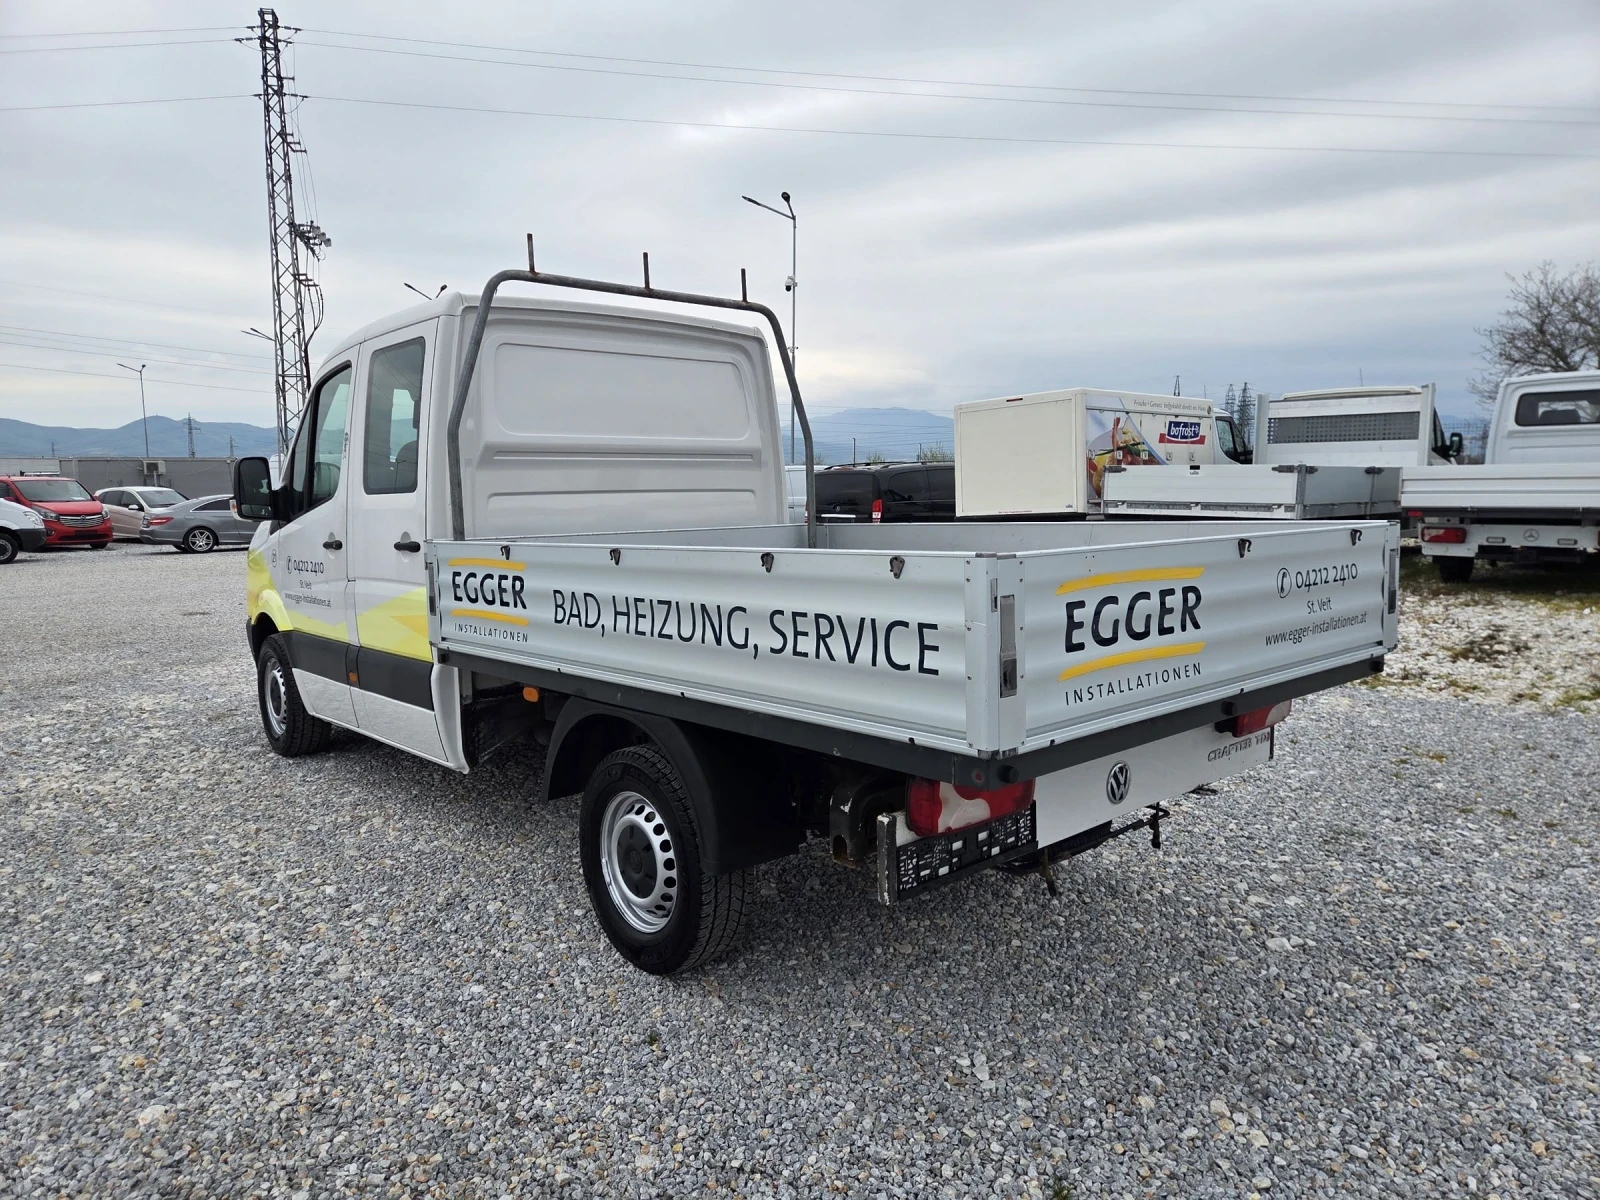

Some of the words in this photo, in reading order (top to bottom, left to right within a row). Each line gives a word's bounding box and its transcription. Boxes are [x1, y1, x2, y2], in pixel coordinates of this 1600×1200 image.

[293, 559, 309, 575] 04212
[310, 561, 325, 577] 2410
[1295, 567, 1330, 593] 04212
[1332, 563, 1358, 587] 2410
[452, 571, 527, 609] EGGER
[1306, 600, 1317, 614] St.
[1317, 597, 1332, 612] Veit
[454, 622, 528, 643] INSTALLATIONEN
[553, 589, 605, 637] BAD,
[613, 595, 759, 660] HEIZUNG,
[770, 609, 940, 676] SERVICE
[1065, 585, 1202, 653] EGGER
[1265, 610, 1367, 646] www.egger-installationen.at
[1065, 662, 1202, 706] INSTALLATIONEN
[1207, 738, 1252, 762] CRAFTER
